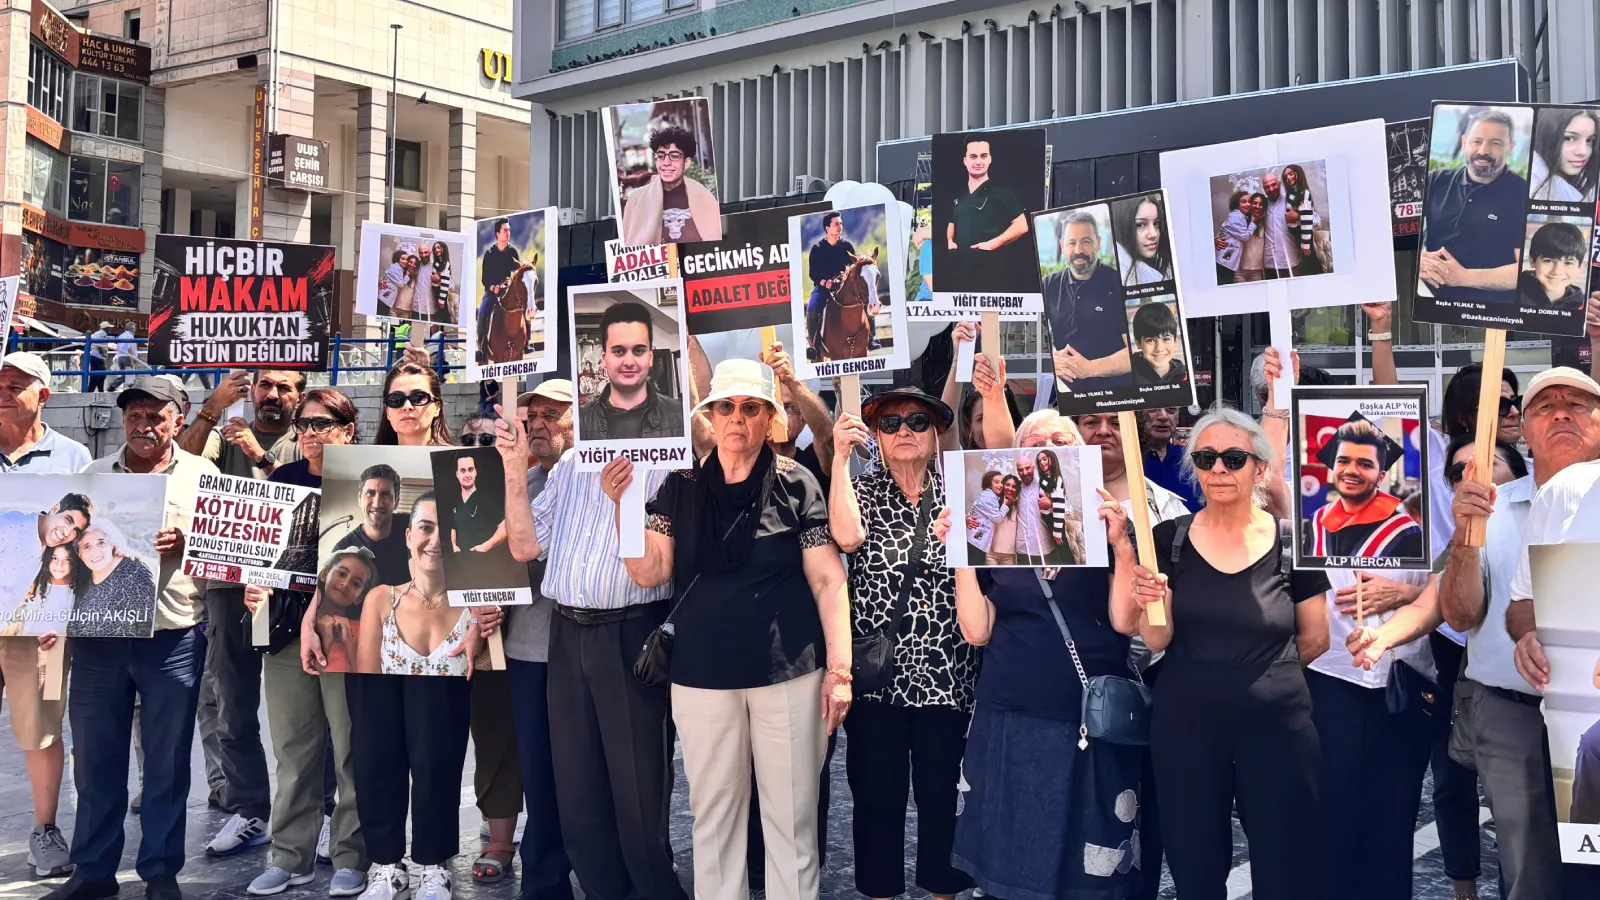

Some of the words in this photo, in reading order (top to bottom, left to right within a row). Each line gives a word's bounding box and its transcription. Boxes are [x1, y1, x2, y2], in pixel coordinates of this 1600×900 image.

[81, 47, 108, 60] KÜLTÜR
[82, 37, 102, 50] HAC
[103, 42, 109, 52] &
[111, 44, 137, 57] UMRE
[81, 58, 98, 68] 444
[101, 61, 112, 71] 13
[113, 63, 125, 73] 63
[254, 91, 263, 142] ULUS
[296, 142, 319, 157] ULUS
[294, 156, 320, 172] ŞEHİR
[252, 149, 261, 218] ŞEHİR
[289, 171, 324, 187] ÇARŞISI
[1398, 204, 1414, 217] 78
[185, 241, 284, 281] HİÇBİR
[614, 245, 668, 274] ADALE
[683, 242, 765, 275] GECİKMİŞ
[180, 276, 308, 312] MAKAM
[691, 283, 751, 308] ADALET
[756, 274, 791, 300] DEĞİ
[952, 294, 978, 307] YİĞİT
[980, 296, 1024, 310] GENÇBAY
[1453, 301, 1474, 309] YILMAZ
[1460, 312, 1524, 325] @baskacanimizyok
[1519, 307, 1537, 315] Başka
[1538, 308, 1559, 316] DORUK
[190, 316, 300, 338] HUKUKTAN
[169, 339, 230, 362] ÜSTÜN
[235, 339, 320, 363] DEĞİLDİR!
[481, 365, 502, 379] YİĞİT
[814, 360, 841, 377] YİĞİT
[1359, 402, 1384, 411] Başka
[1385, 402, 1402, 410] ALP
[1402, 402, 1418, 410] Yok
[579, 446, 616, 464] YİĞİT
[620, 447, 687, 466] GENÇBAY
[199, 474, 232, 493] GRAND
[234, 479, 271, 499] KARTAL
[273, 485, 296, 503] OTEL
[194, 495, 284, 527] KÖTÜLÜK
[191, 516, 283, 546] MÜZESİNE
[188, 535, 279, 559] DÖNÜŞTÜRÜLSÜN!
[189, 560, 205, 577] 78
[205, 563, 217, 571] CAN
[217, 564, 228, 573] İÇİN
[1324, 557, 1348, 567] ALP
[1350, 557, 1401, 567] MERCAN
[248, 569, 265, 579] İHMAL
[462, 590, 482, 603] YİĞİT
[482, 590, 516, 604] GENÇBAY
[103, 607, 148, 625] AKİŞLİ
[1577, 833, 1600, 853] A
